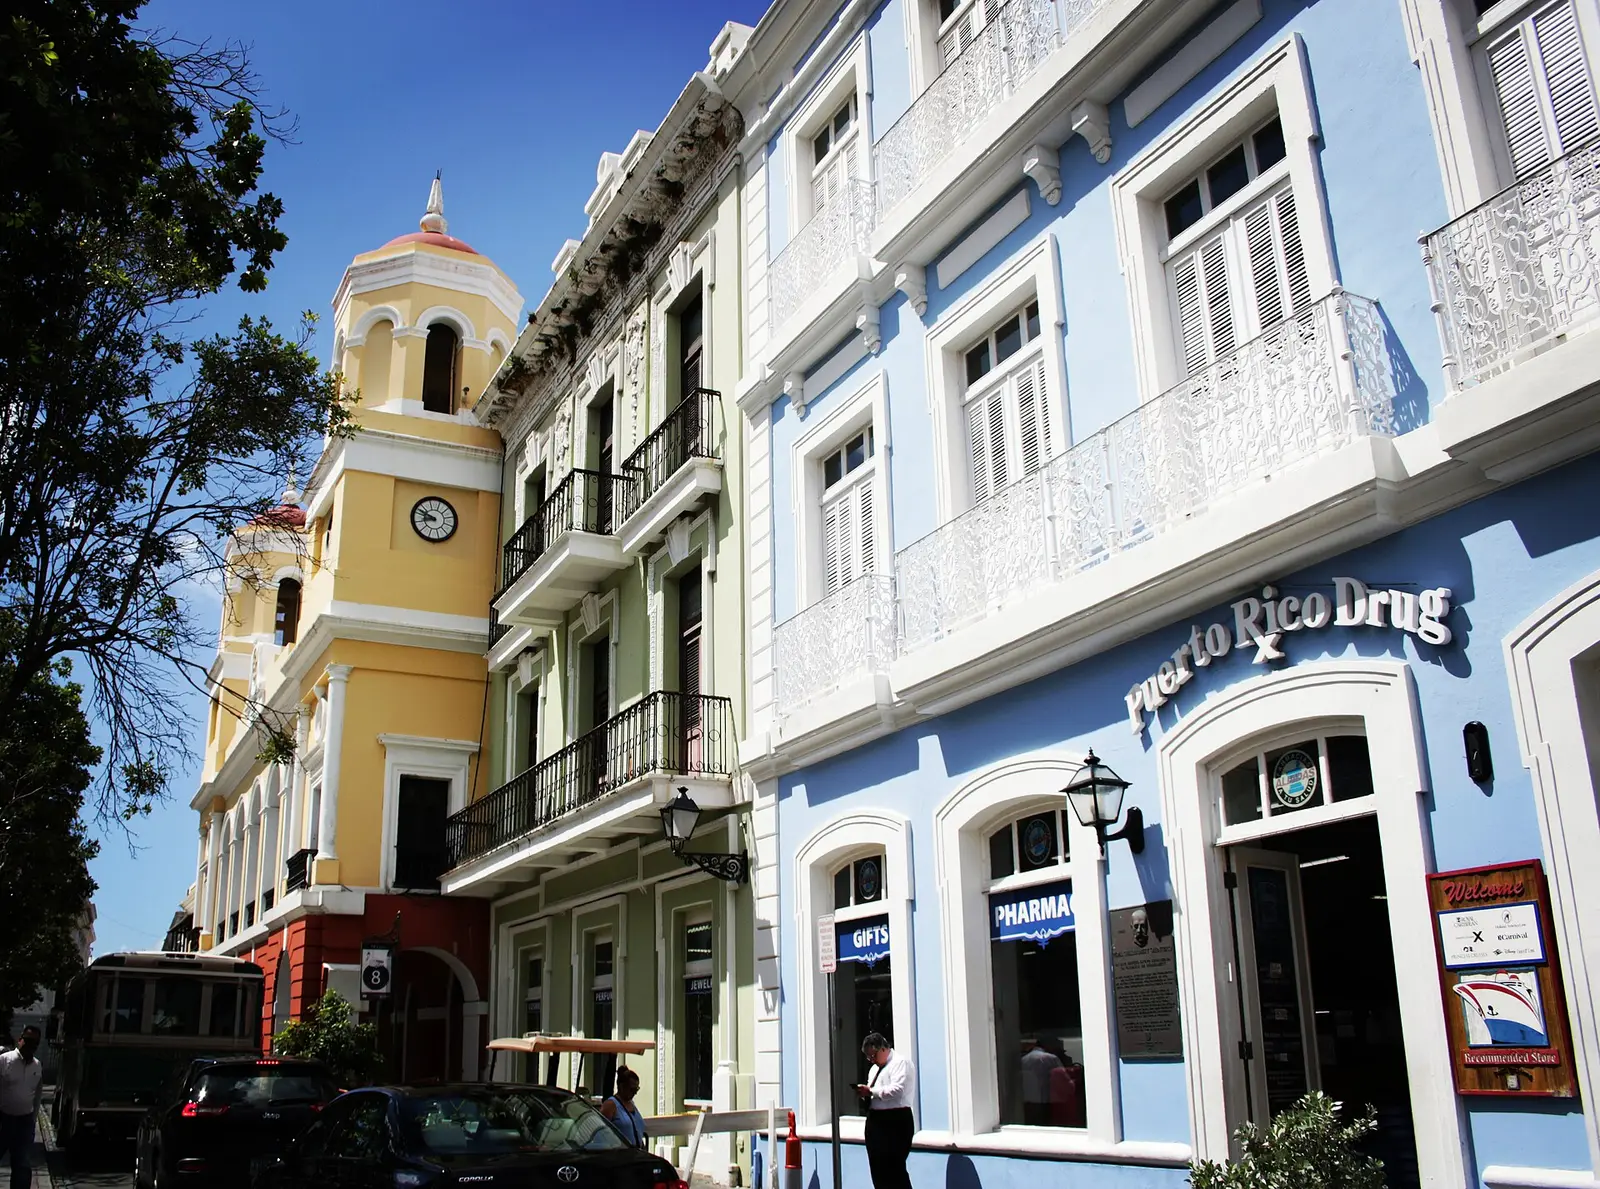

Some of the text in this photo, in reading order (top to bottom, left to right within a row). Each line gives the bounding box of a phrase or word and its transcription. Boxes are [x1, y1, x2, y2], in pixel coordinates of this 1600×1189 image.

[1124, 577, 1452, 735] Puerto Rico Drug
[1284, 794, 1293, 803] TU
[1295, 779, 1314, 804] SALUD
[1442, 881, 1524, 902] Welcome
[853, 924, 888, 948] GIFTS
[1501, 932, 1528, 941] Carnival
[372, 970, 381, 985] 8
[1464, 1051, 1557, 1064] Recommended Store
[262, 1111, 281, 1120] Jeep
[458, 1175, 494, 1183] COROLLA
